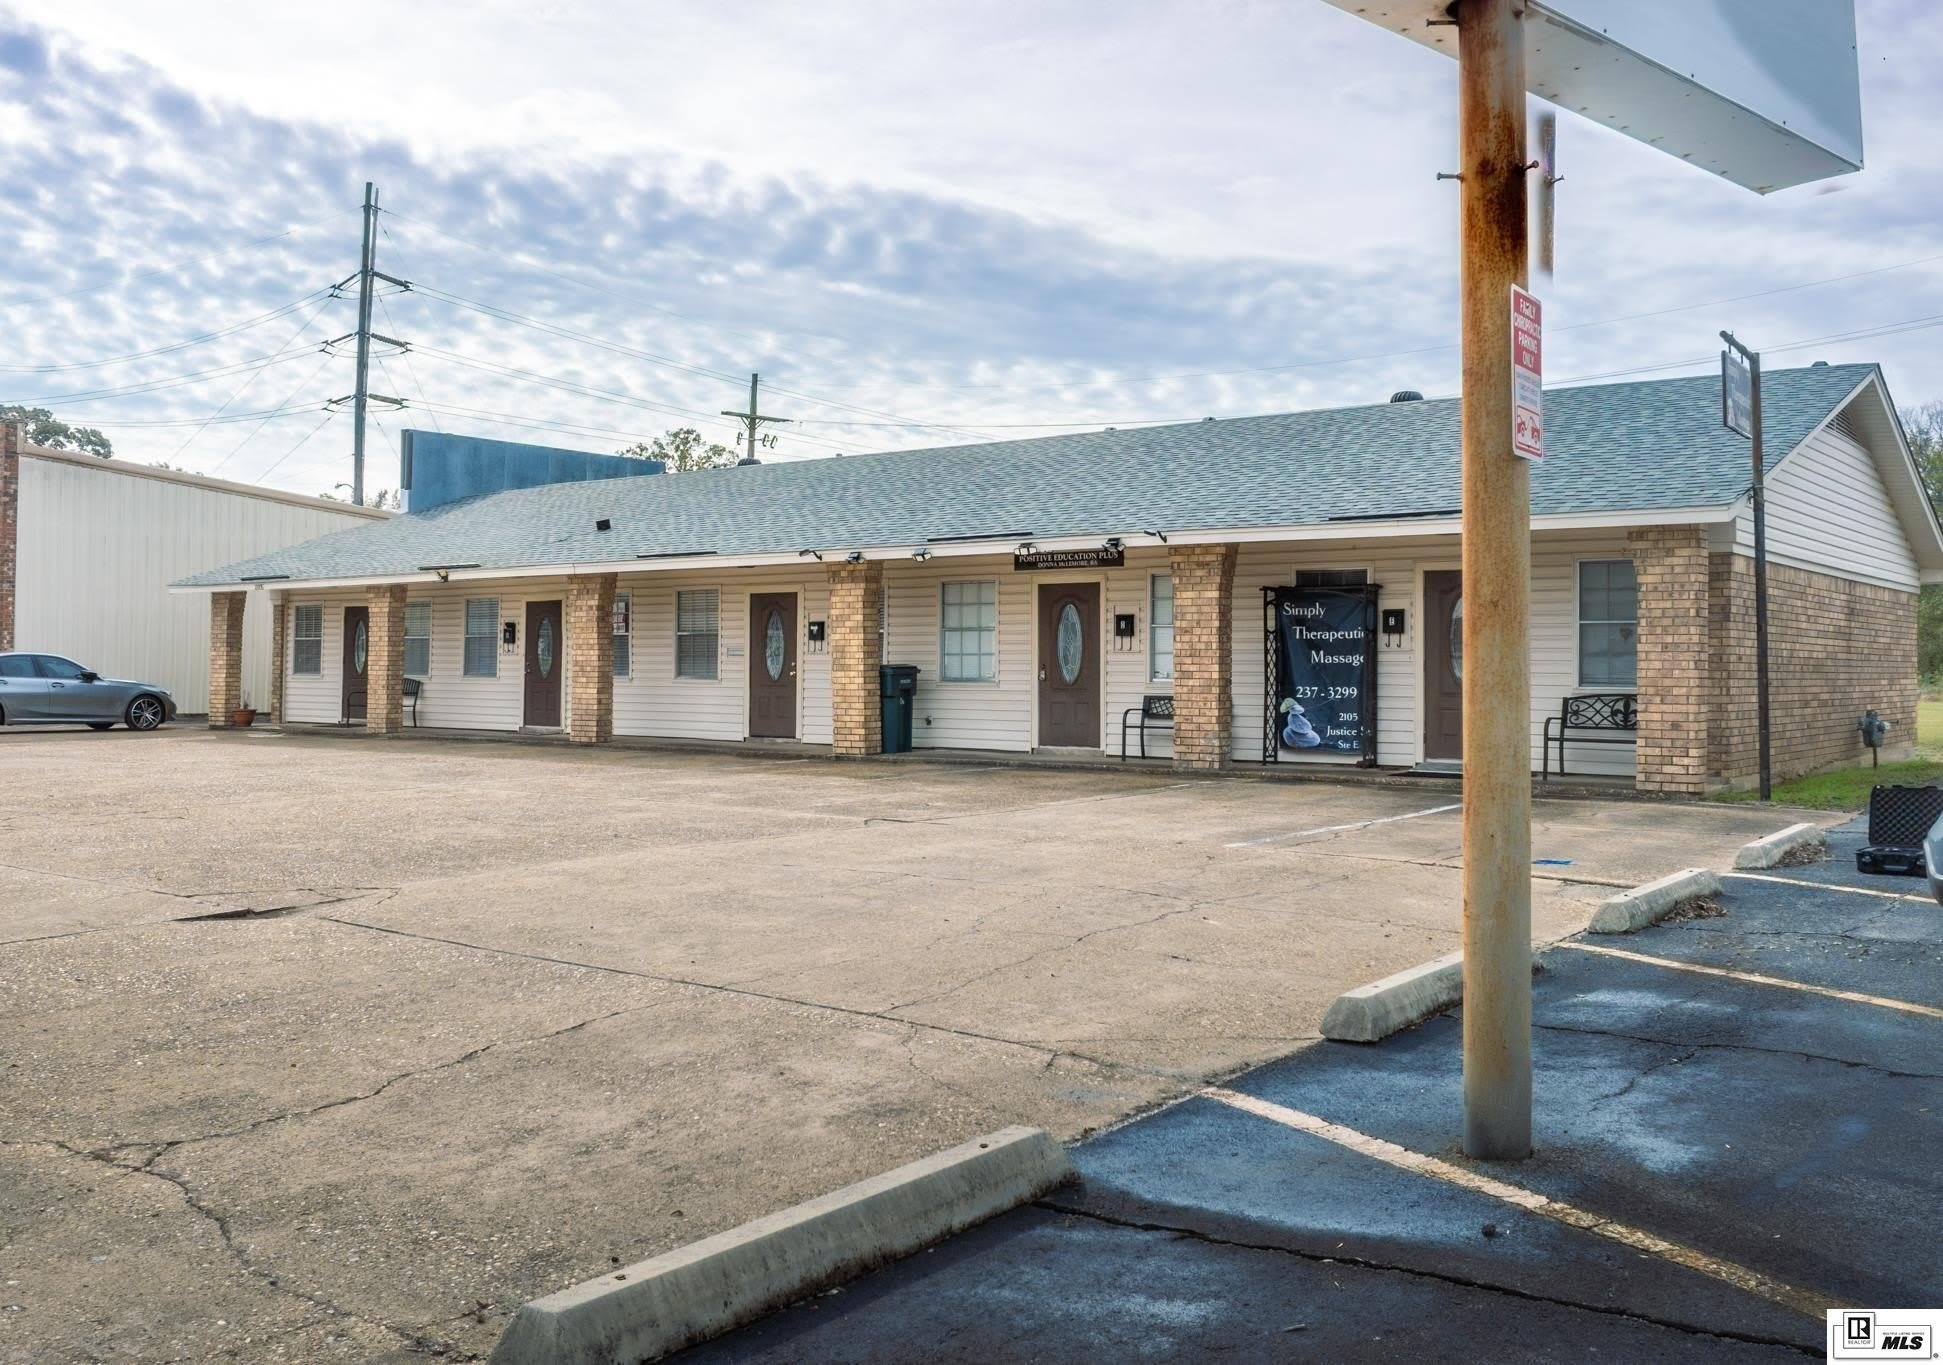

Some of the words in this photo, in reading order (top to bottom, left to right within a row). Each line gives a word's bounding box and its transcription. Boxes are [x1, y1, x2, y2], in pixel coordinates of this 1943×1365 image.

[1519, 331, 1538, 353] PARKING
[1522, 351, 1535, 369] ONLY
[1020, 553, 1052, 563] POSITIVE
[1053, 552, 1097, 561] EDUCATION
[1099, 550, 1119, 559] PLUS
[1282, 602, 1326, 618] Simply
[1339, 712, 1358, 721] 2105
[1326, 725, 1358, 737] Justice
[1338, 740, 1352, 749] Ste
